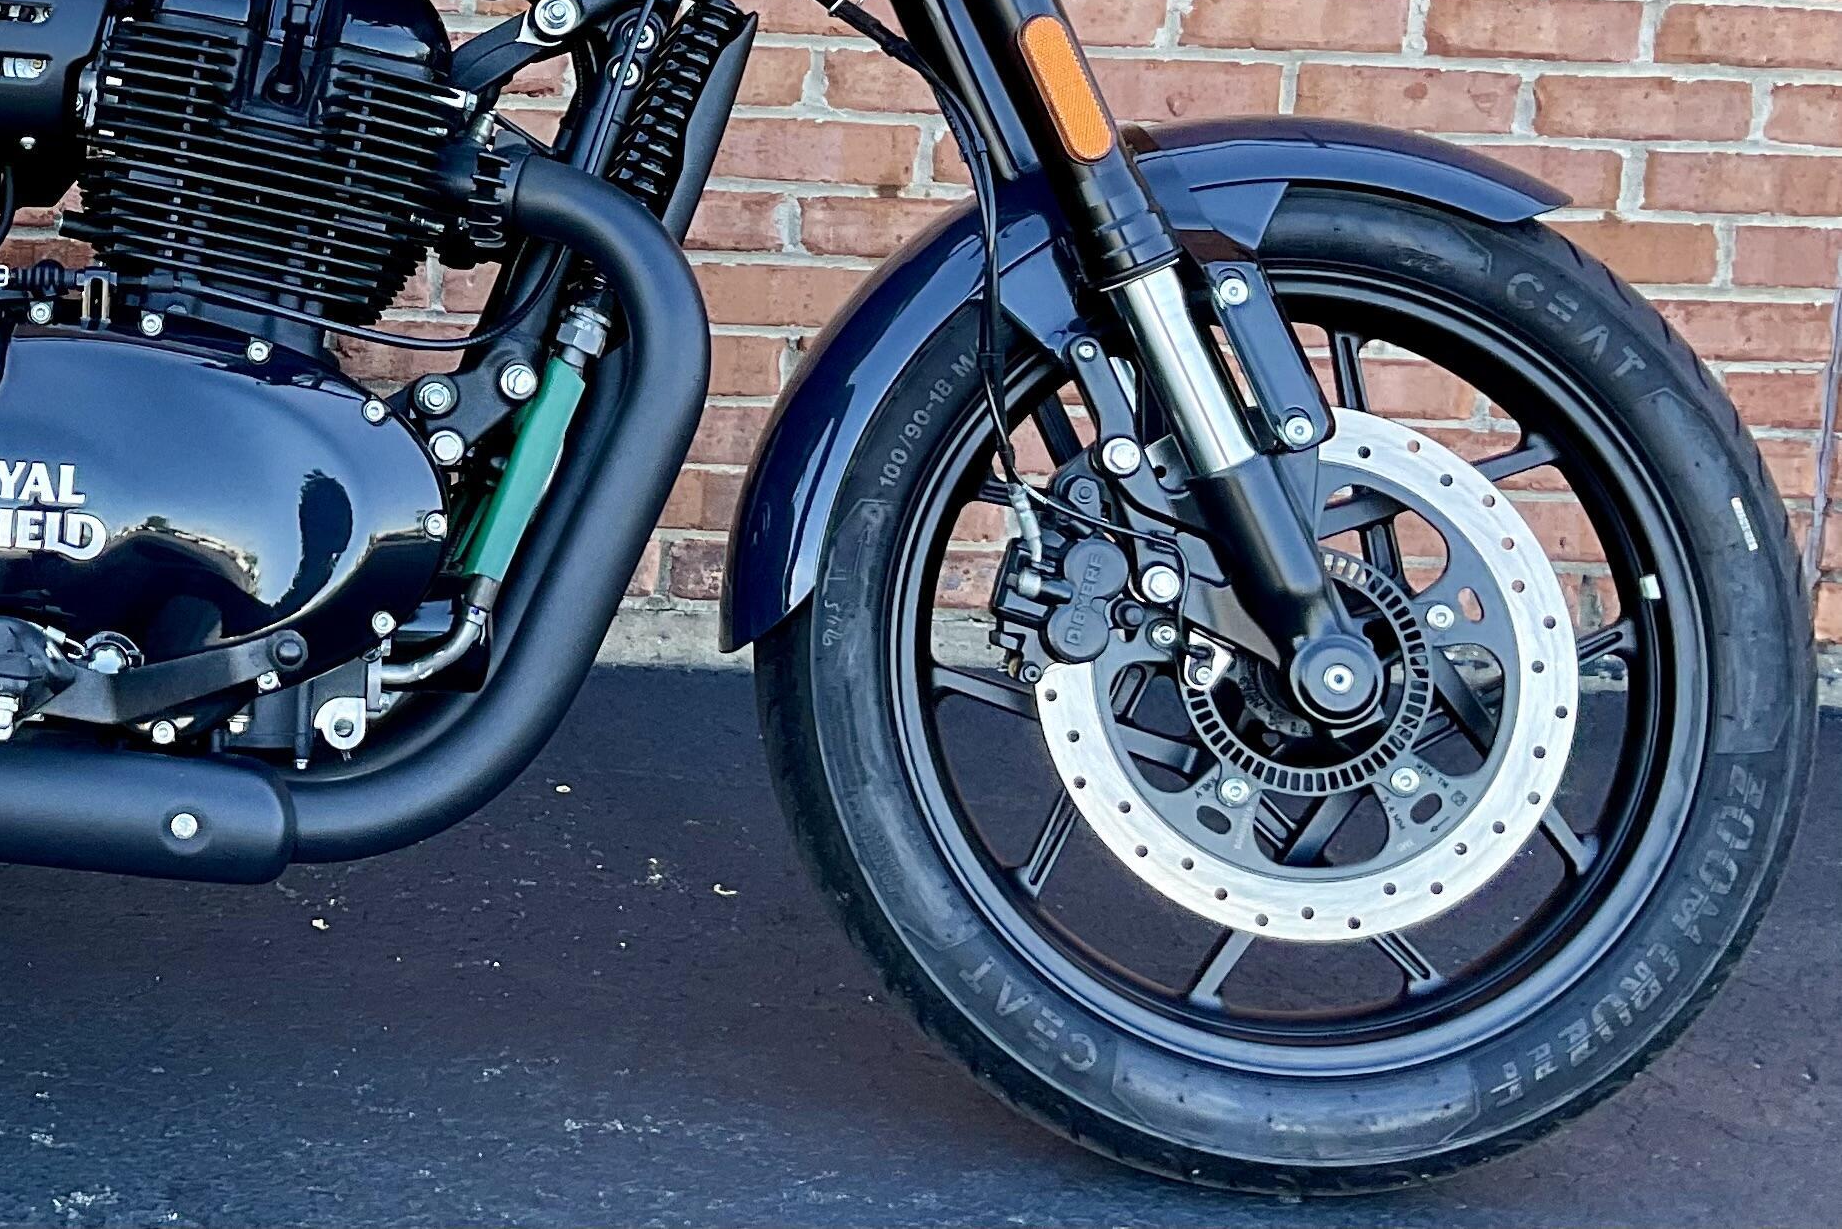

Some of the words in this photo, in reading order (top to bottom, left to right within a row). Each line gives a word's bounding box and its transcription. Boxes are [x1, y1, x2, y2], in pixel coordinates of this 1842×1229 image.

[1505, 272, 1647, 379] CEAT
[878, 379, 954, 488] 100/90-18
[1671, 763, 1767, 945] ZOOM
[958, 954, 1097, 1072] CEAT
